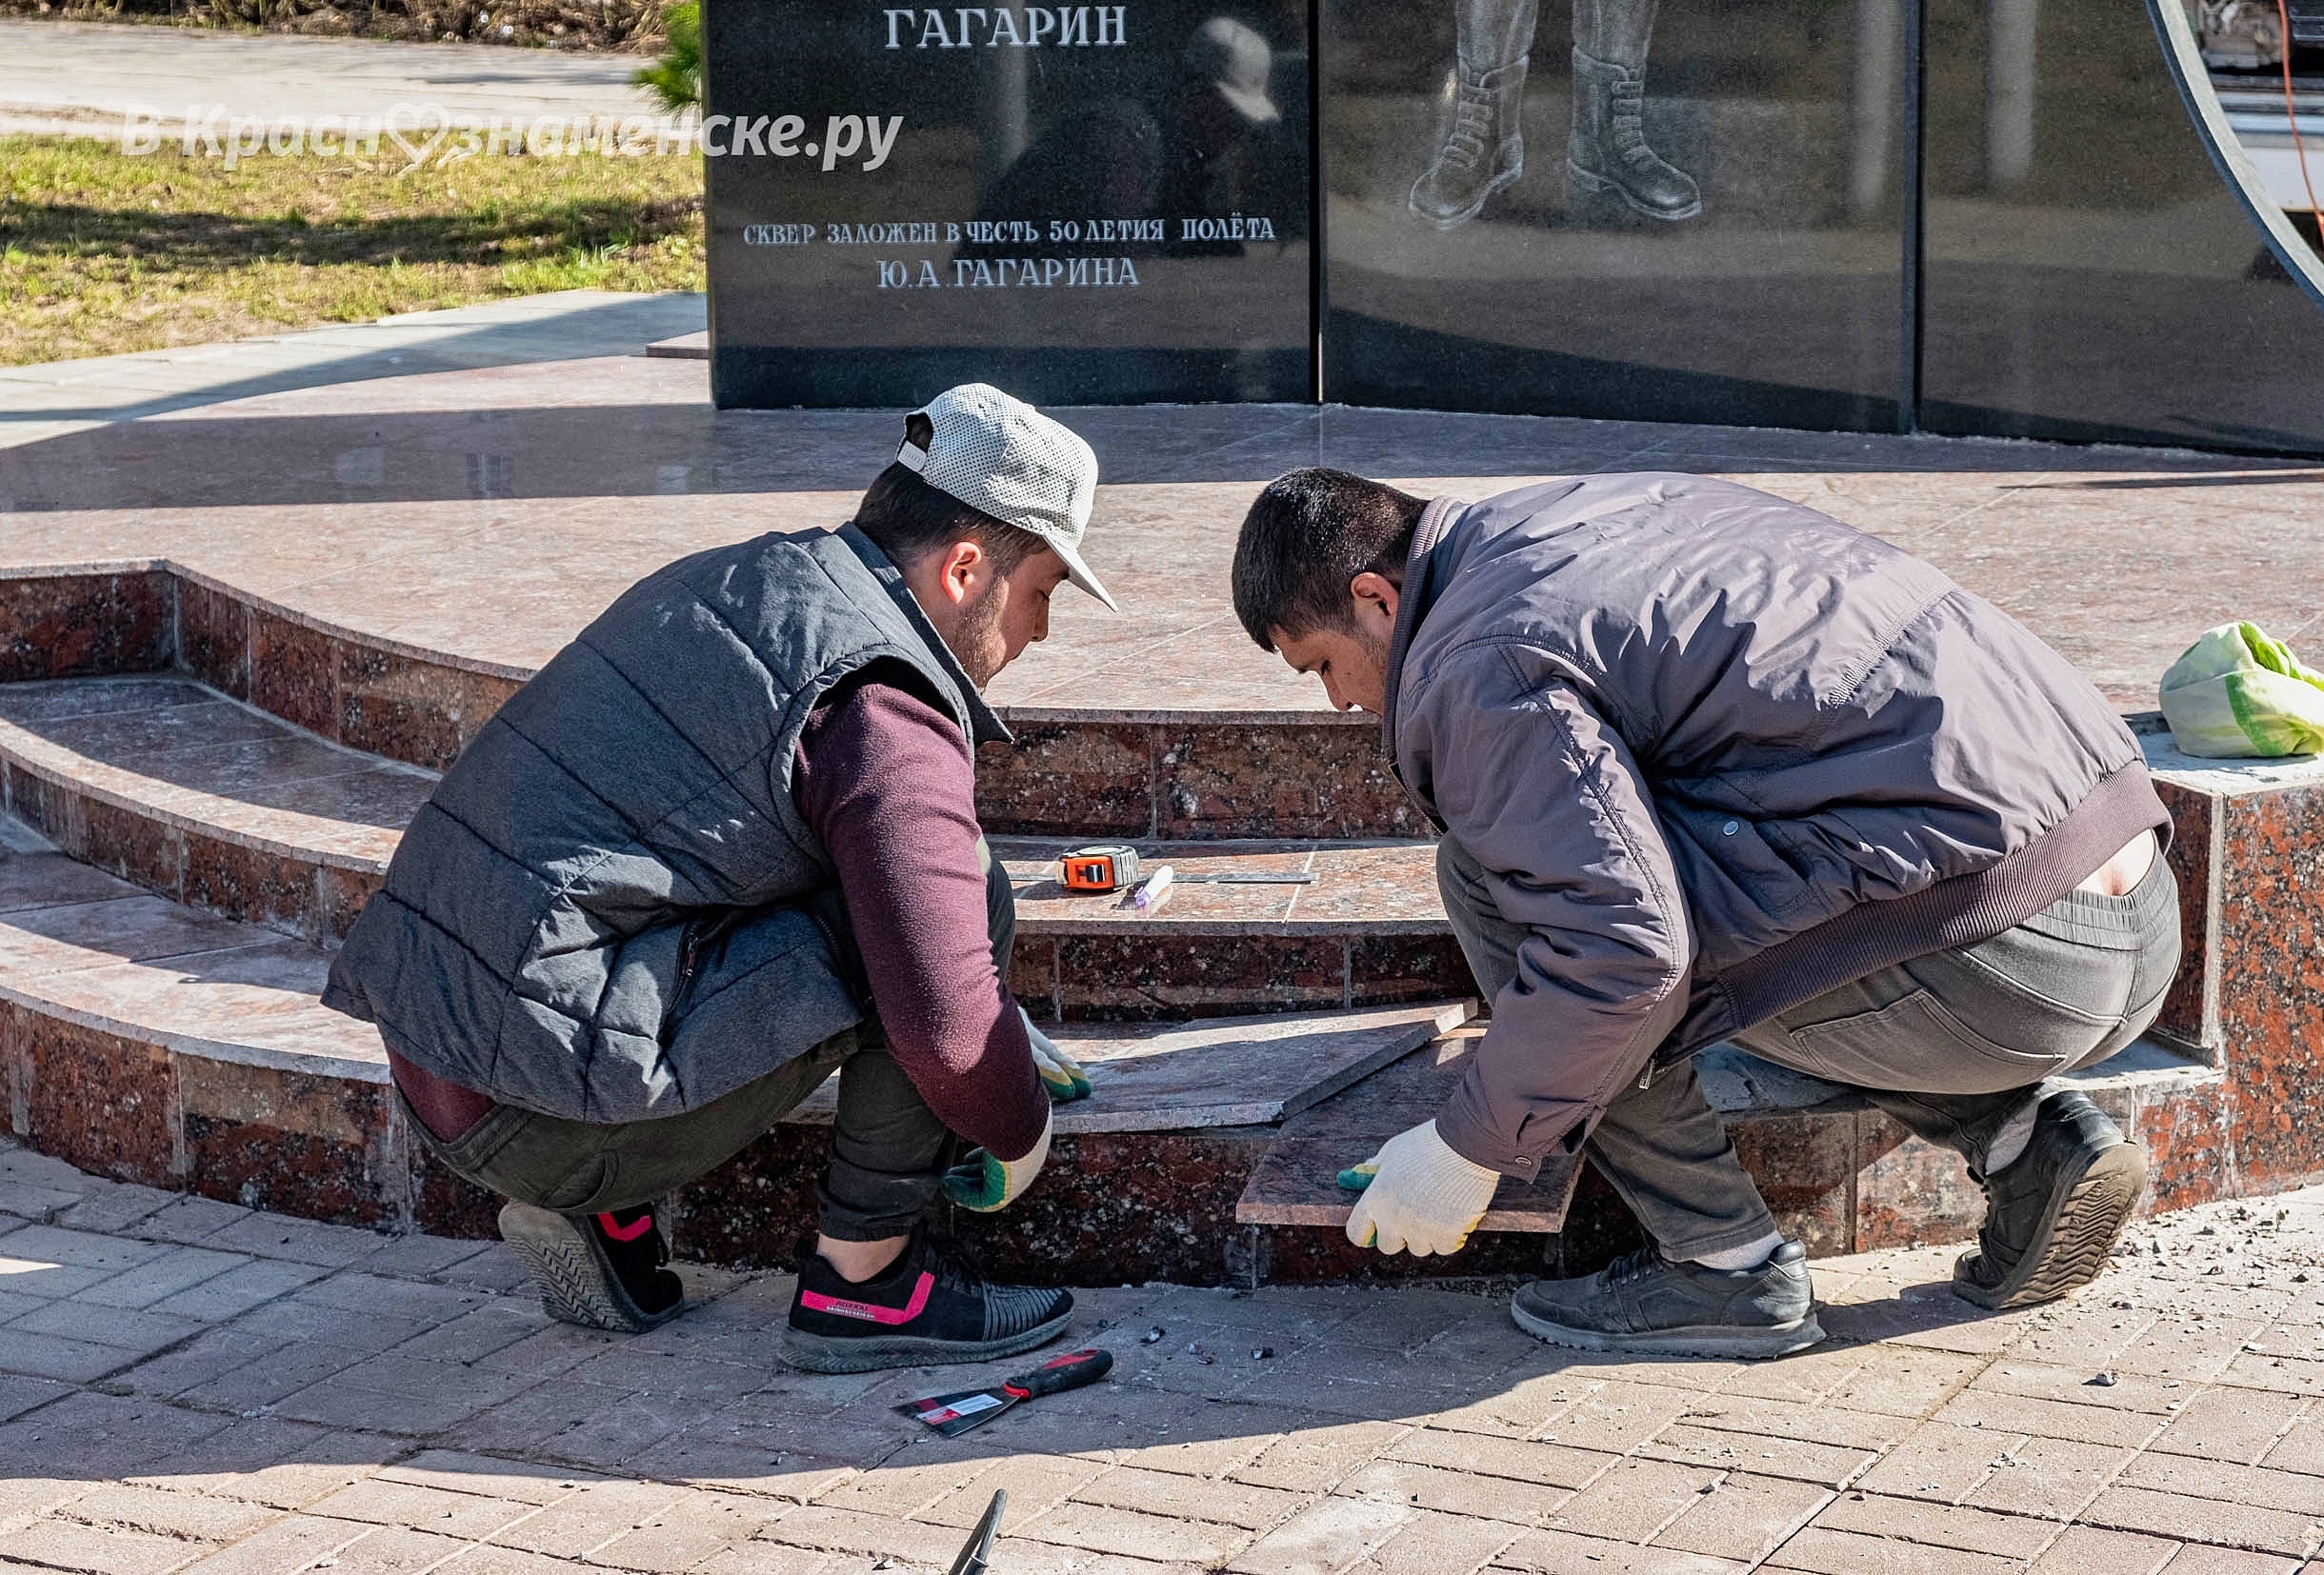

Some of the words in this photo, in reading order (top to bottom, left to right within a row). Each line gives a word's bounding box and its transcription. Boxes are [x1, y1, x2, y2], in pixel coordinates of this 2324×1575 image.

[882, 6, 1128, 49] ГАГАРИН
[743, 223, 816, 245] СКВЕР
[827, 222, 938, 244] ЗАЛОЖЕН
[944, 221, 961, 244] В
[964, 220, 1040, 244] ЧЕСТЬ
[1049, 220, 1081, 243] 50
[1085, 219, 1166, 241] ЛЕТИЯ
[1180, 211, 1275, 241] ПОЛЁТА
